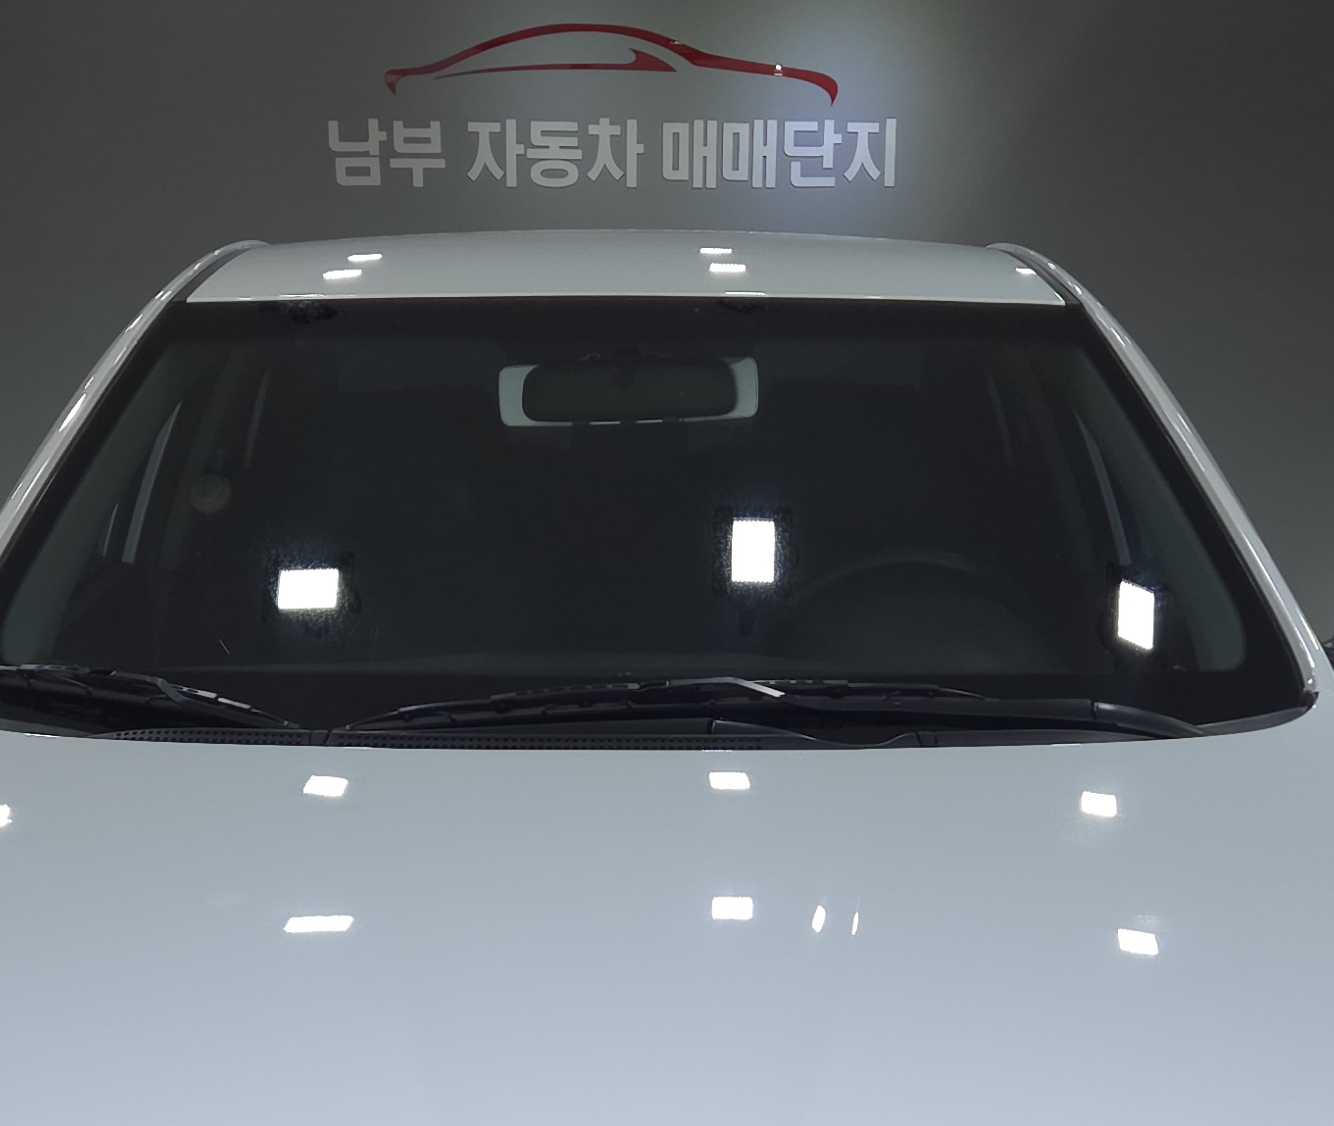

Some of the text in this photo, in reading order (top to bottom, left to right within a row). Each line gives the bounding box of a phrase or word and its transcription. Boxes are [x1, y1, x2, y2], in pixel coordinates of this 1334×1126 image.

[328, 118, 897, 189] 남부 자동차 매매단지
